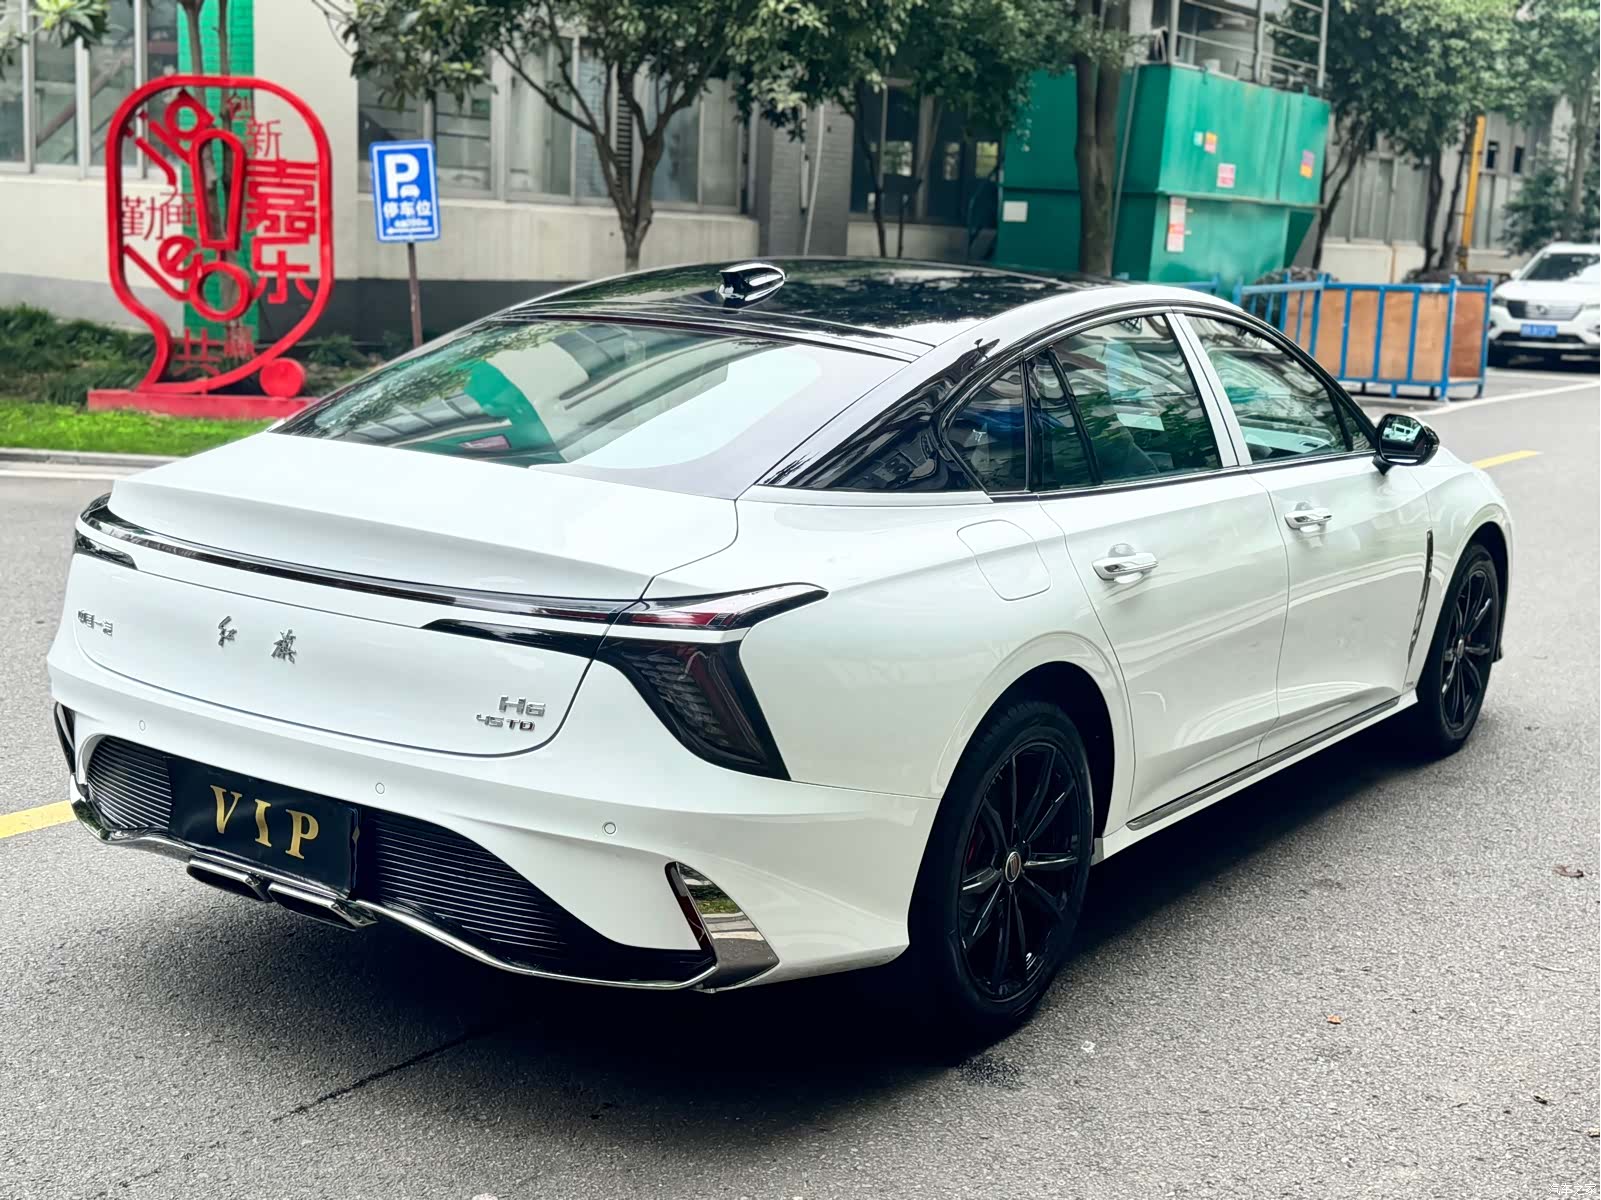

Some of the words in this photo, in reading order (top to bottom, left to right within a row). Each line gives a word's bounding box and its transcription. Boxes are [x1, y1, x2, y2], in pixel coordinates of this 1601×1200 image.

[385, 153, 420, 199] P
[246, 157, 318, 303] 嘉乐
[383, 200, 432, 218] 停车位
[499, 695, 546, 717] H6
[210, 785, 319, 859] VIP
